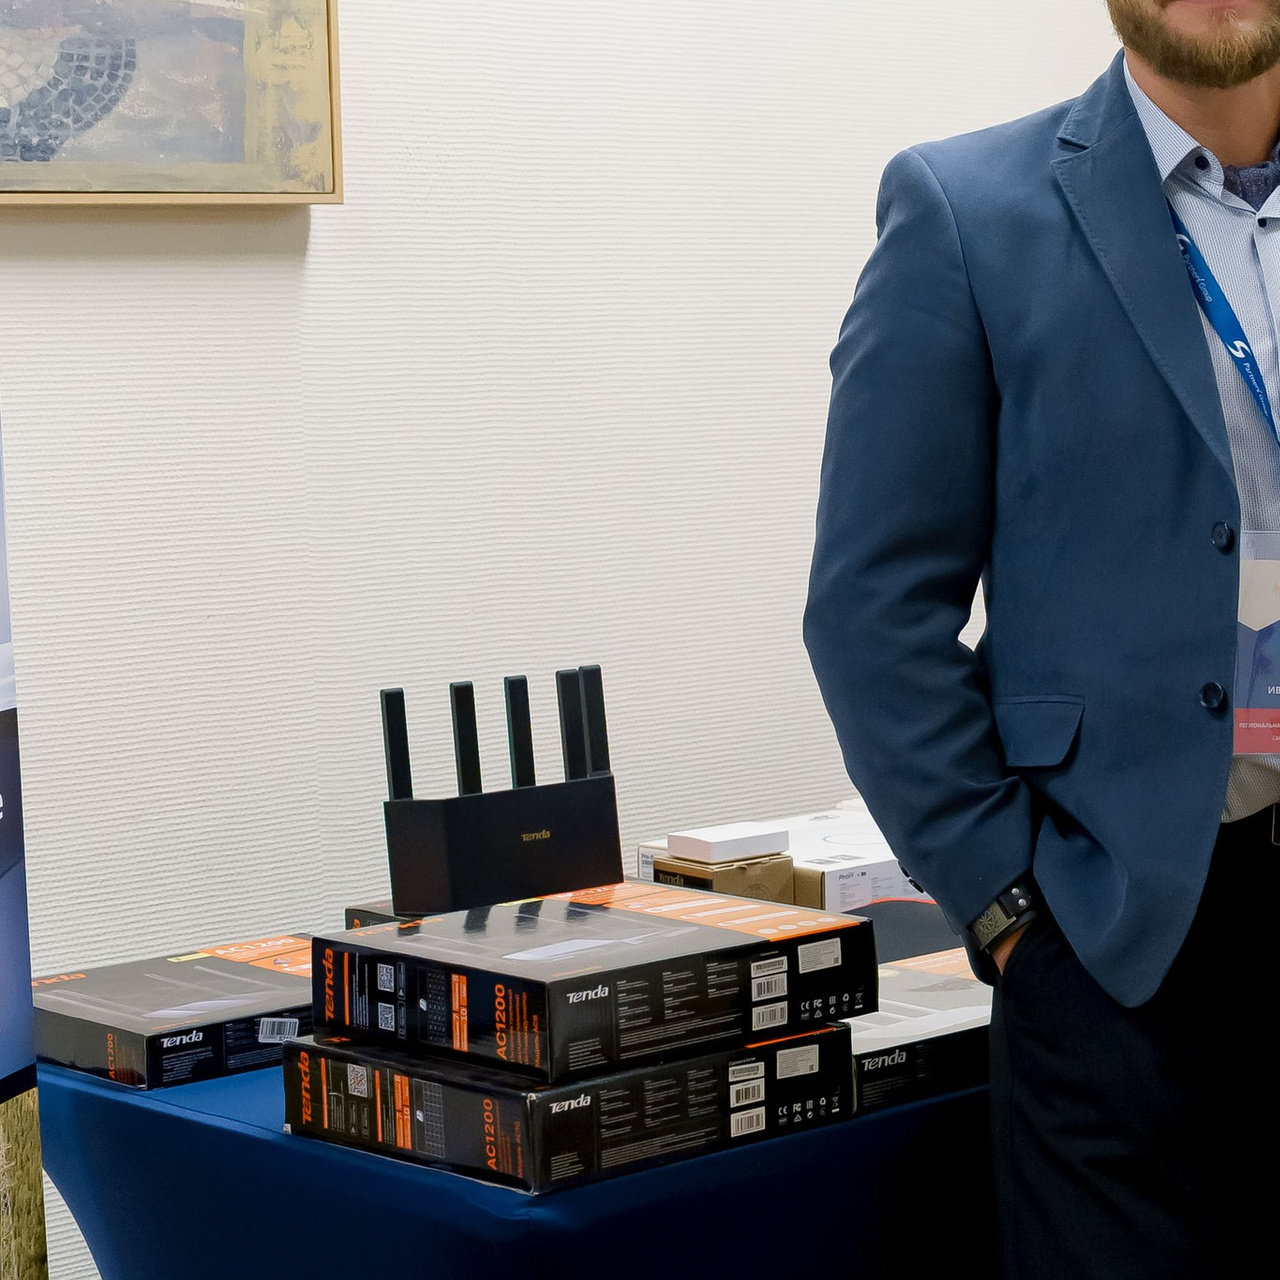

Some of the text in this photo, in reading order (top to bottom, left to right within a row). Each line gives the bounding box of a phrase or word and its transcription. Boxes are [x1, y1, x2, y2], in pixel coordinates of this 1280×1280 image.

[521, 829, 551, 842] Tenda
[323, 948, 335, 1022] Tenda
[566, 984, 609, 1004] Tenda
[160, 1030, 203, 1048] Tenda
[494, 984, 507, 1060] AC1200
[107, 1032, 116, 1080] AC1200
[861, 1049, 907, 1071] Tenda
[297, 1051, 312, 1124] Tenda
[549, 1094, 592, 1114] Tenda
[483, 1099, 498, 1171] AC1200
